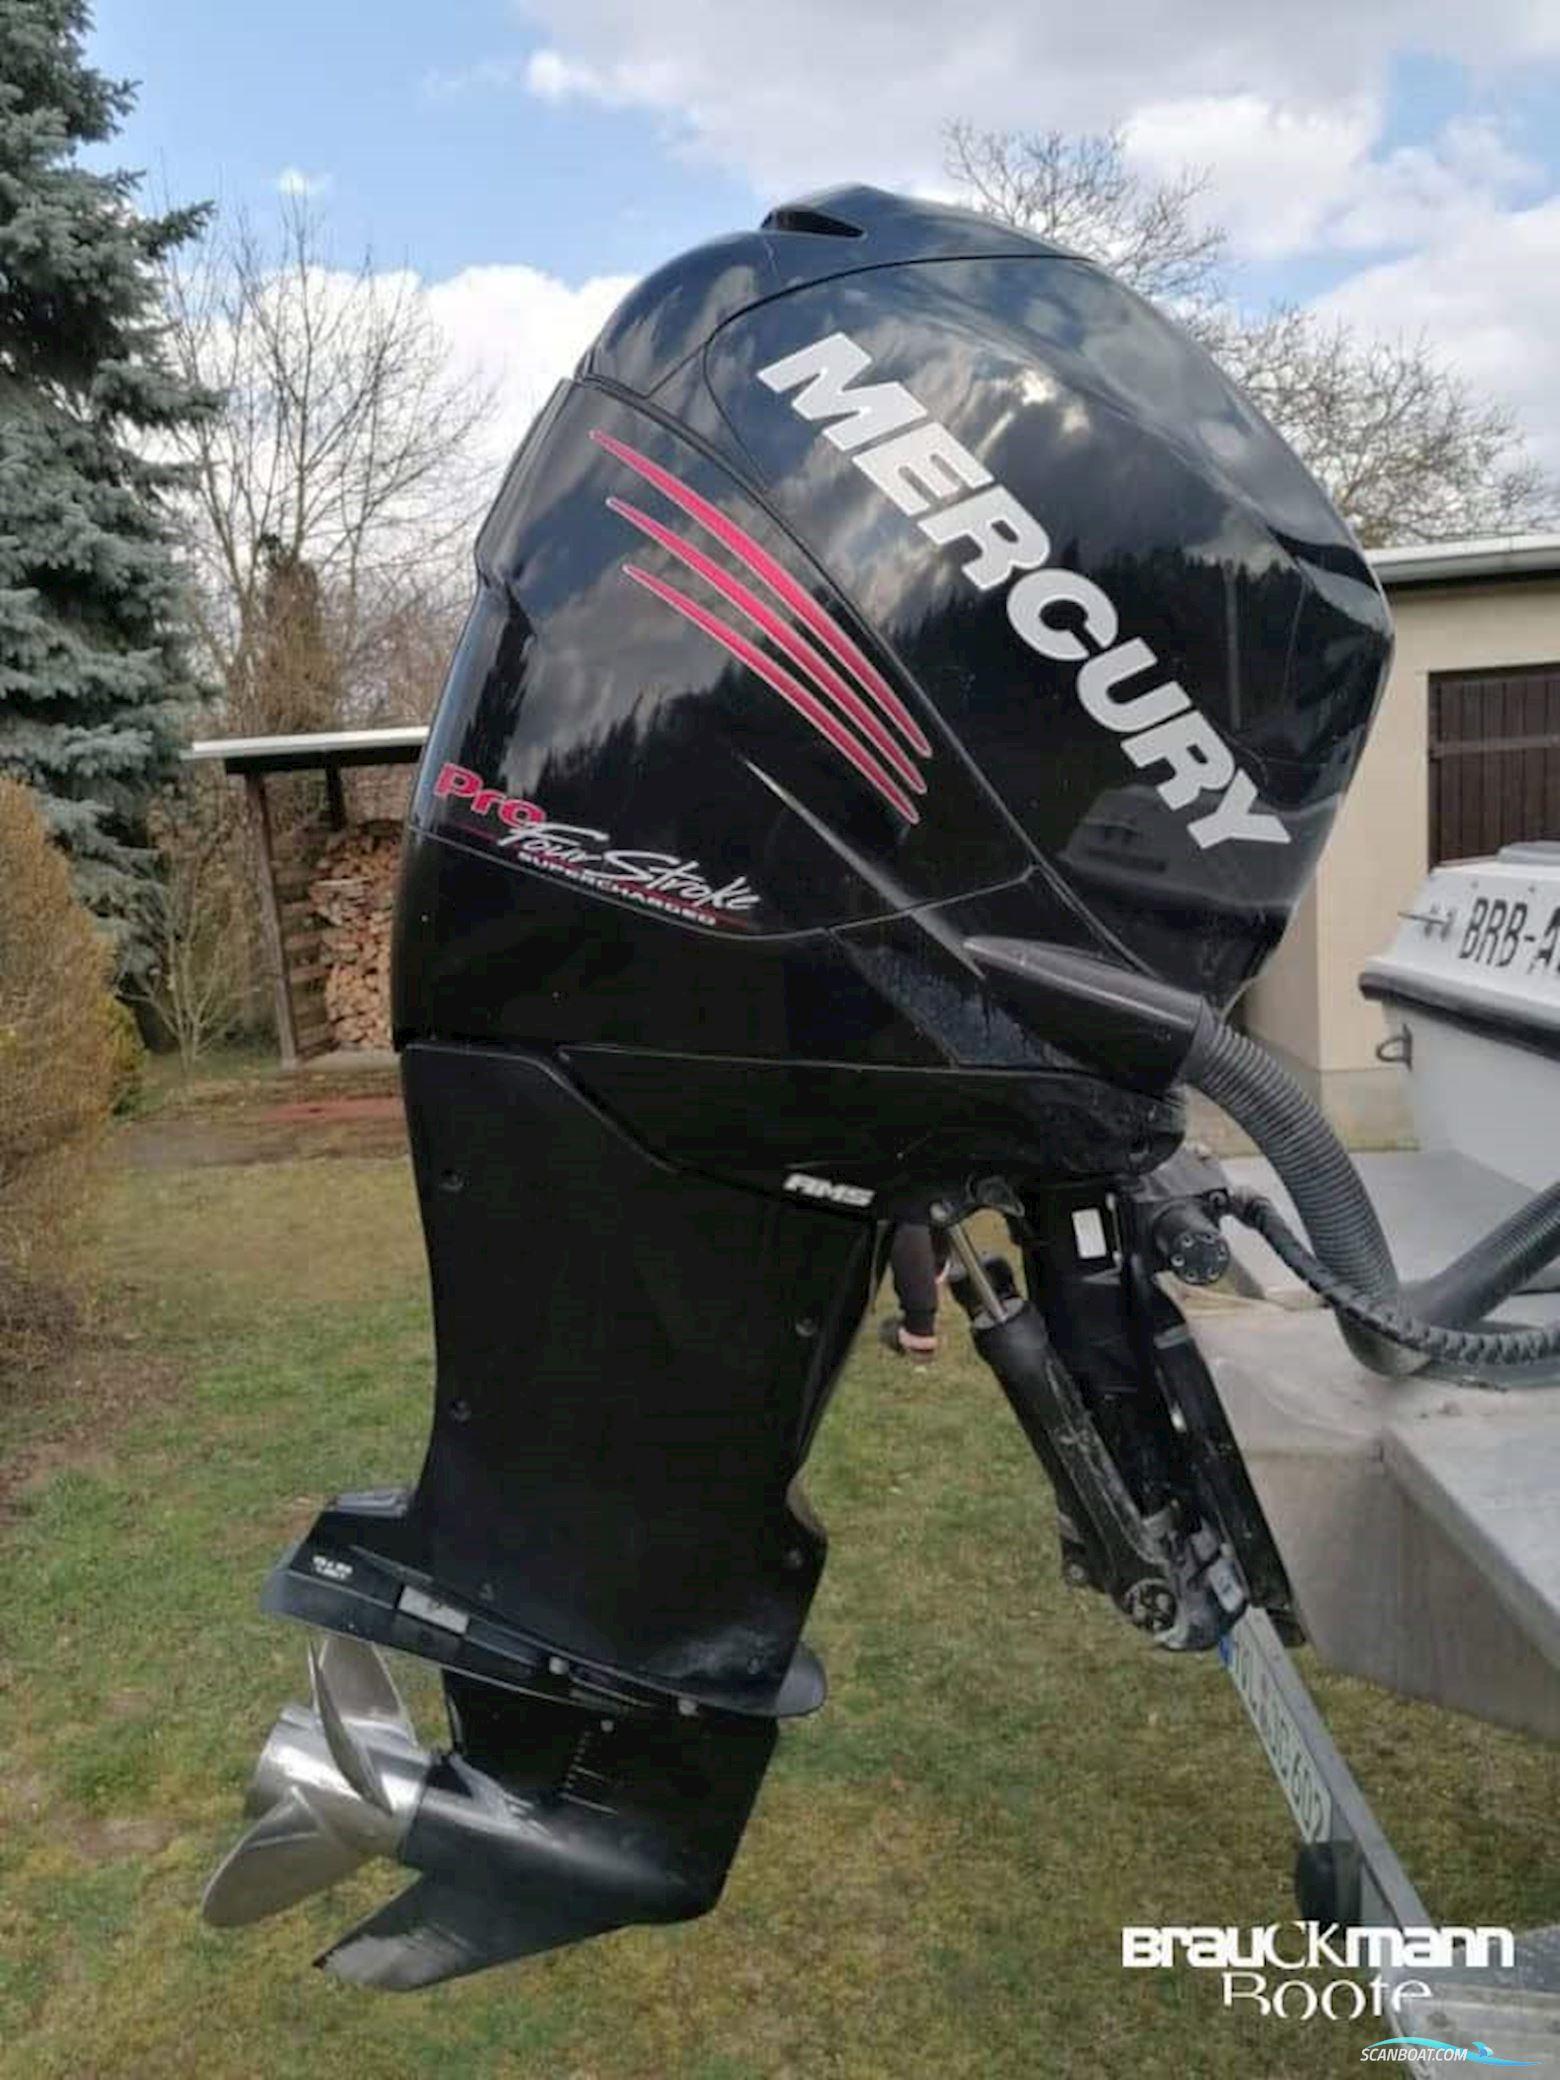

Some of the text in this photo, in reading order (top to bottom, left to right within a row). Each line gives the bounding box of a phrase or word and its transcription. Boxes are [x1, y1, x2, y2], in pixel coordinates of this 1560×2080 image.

[757, 331, 1291, 849] MERCURY
[433, 762, 547, 829] Pro
[1459, 896, 1560, 976] BRB-A
